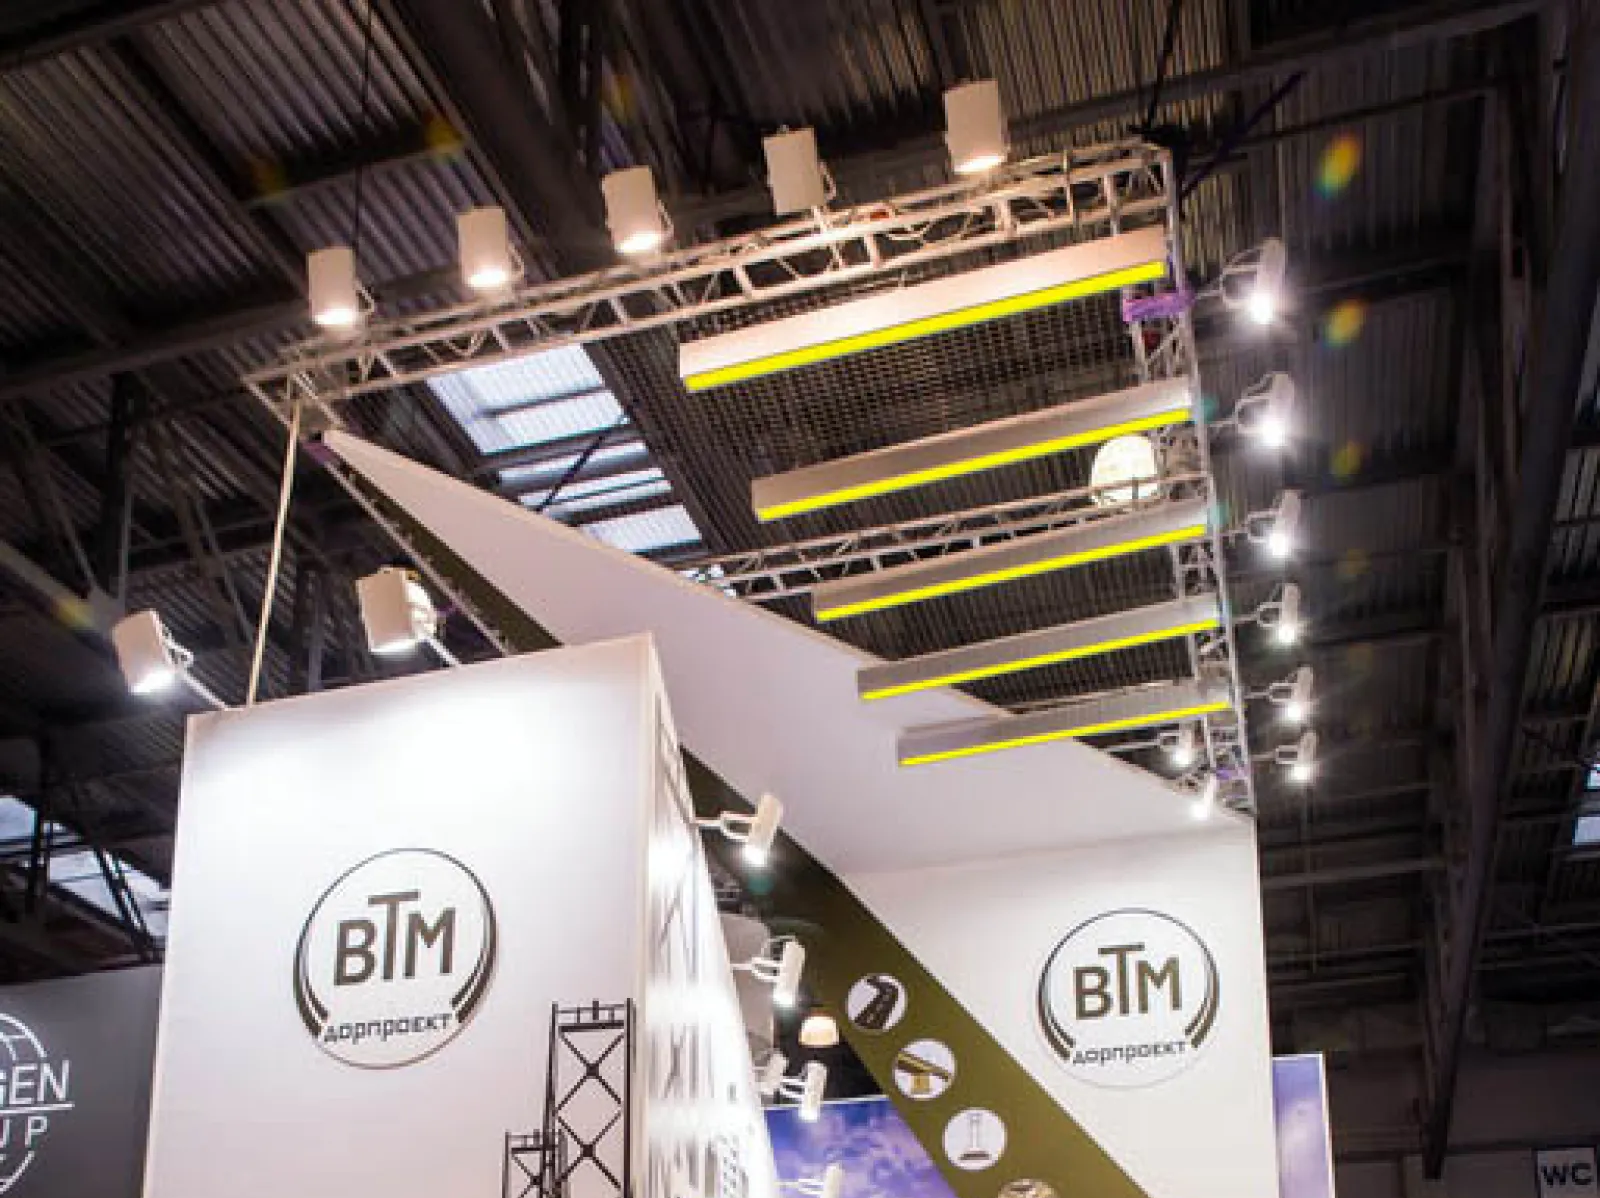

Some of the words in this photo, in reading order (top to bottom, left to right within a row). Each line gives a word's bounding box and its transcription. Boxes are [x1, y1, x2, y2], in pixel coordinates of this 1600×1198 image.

[333, 888, 456, 986] ВТМ
[1073, 941, 1183, 1020] ВТМ
[1541, 1162, 1593, 1187] WC
